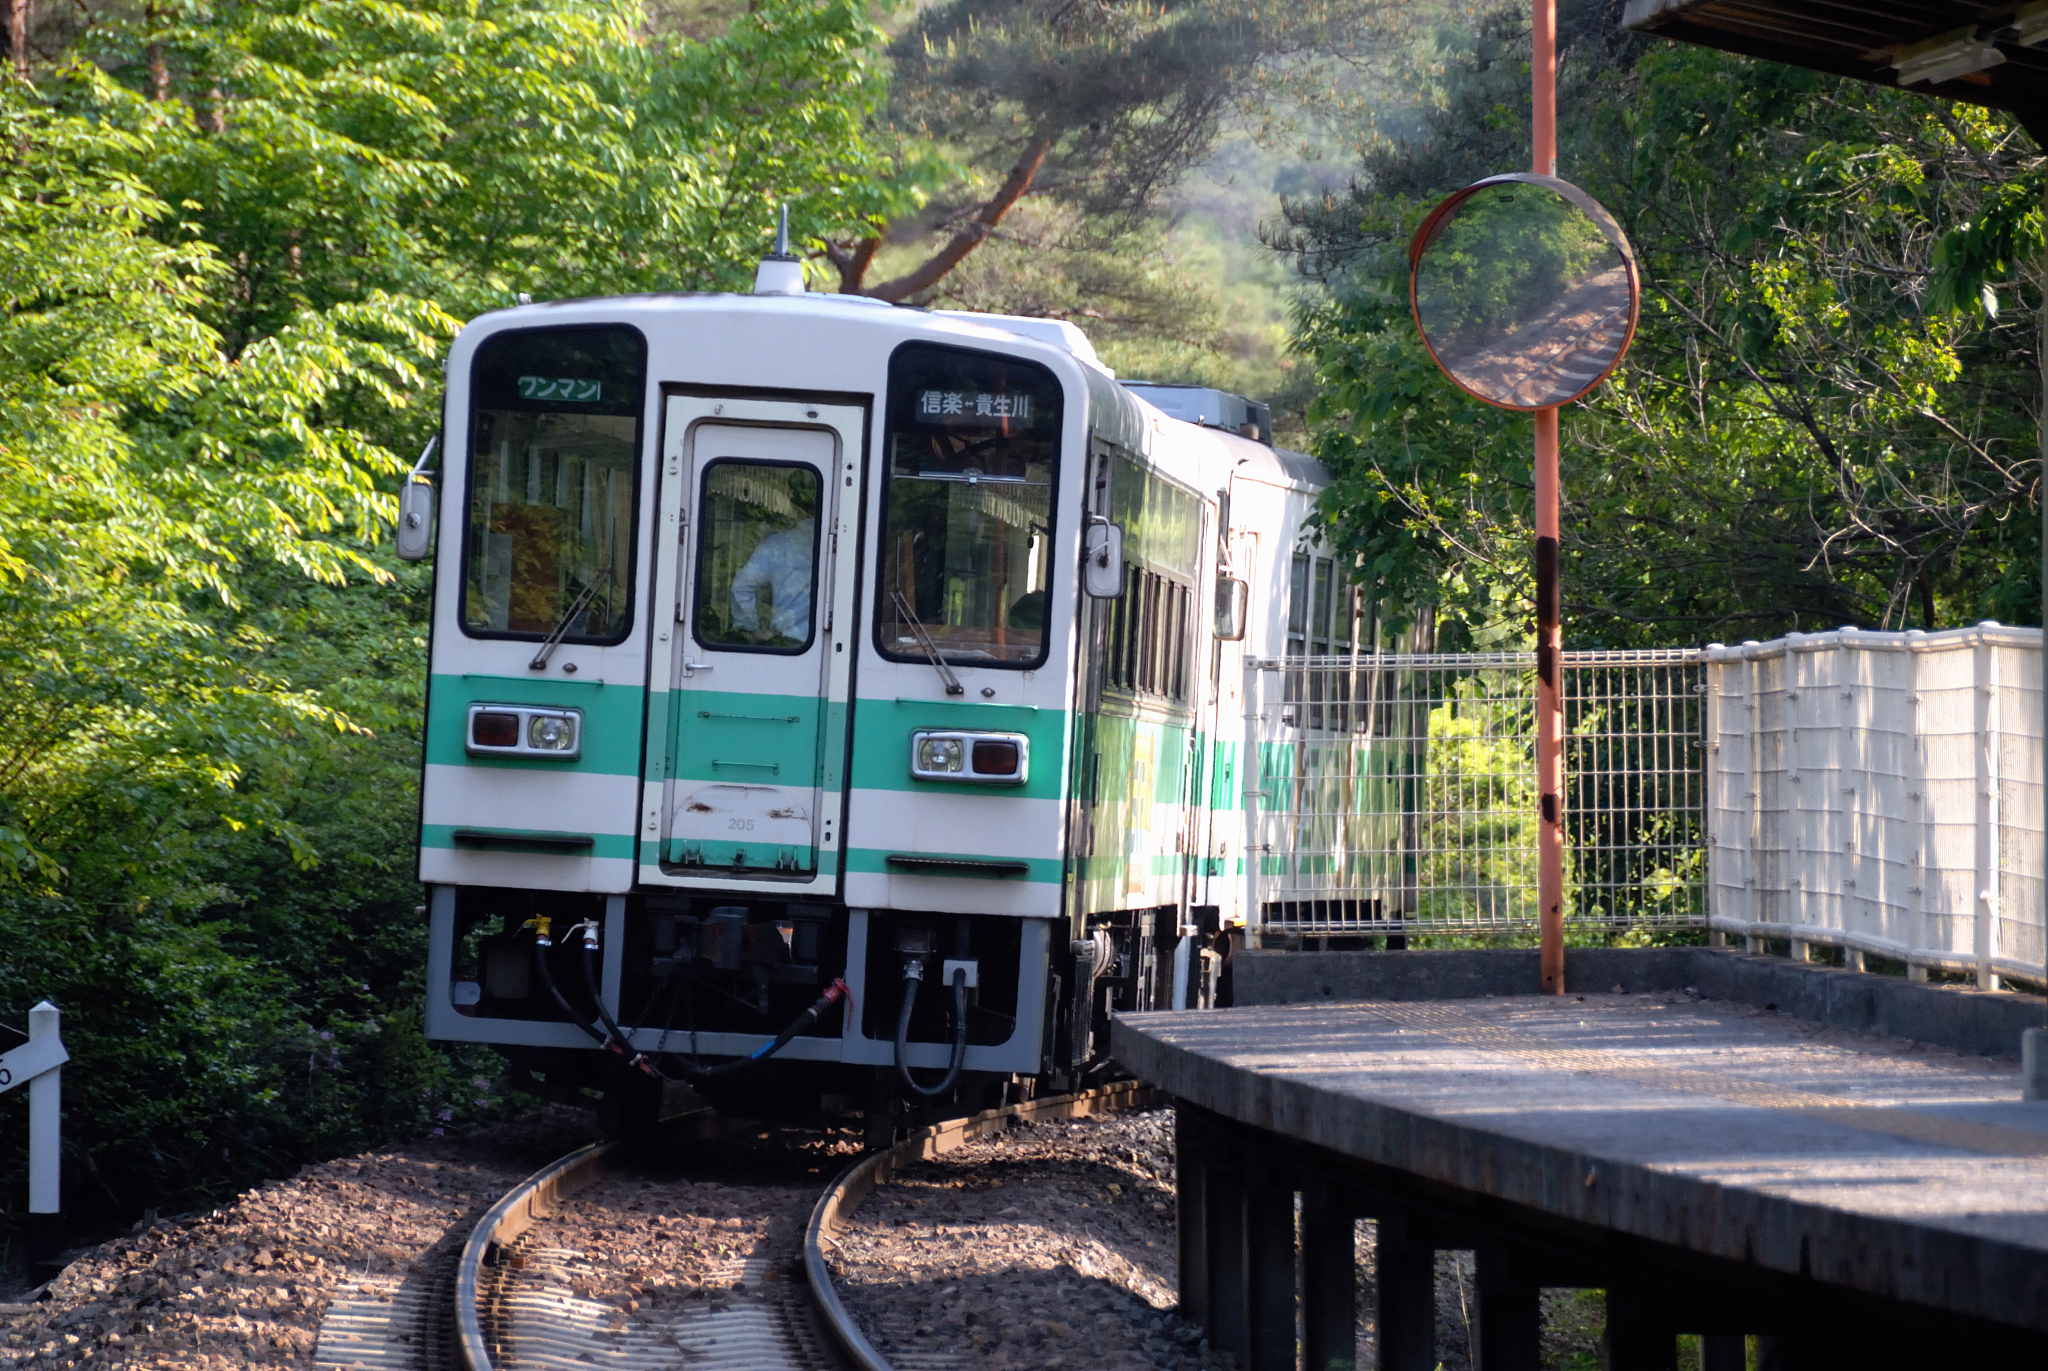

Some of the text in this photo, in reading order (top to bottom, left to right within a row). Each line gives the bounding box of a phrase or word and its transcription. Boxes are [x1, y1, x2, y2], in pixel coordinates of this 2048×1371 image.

[517, 376, 597, 399] ワンマン
[921, 390, 1029, 418] 信楽 貴生川
[728, 818, 755, 831] 205
